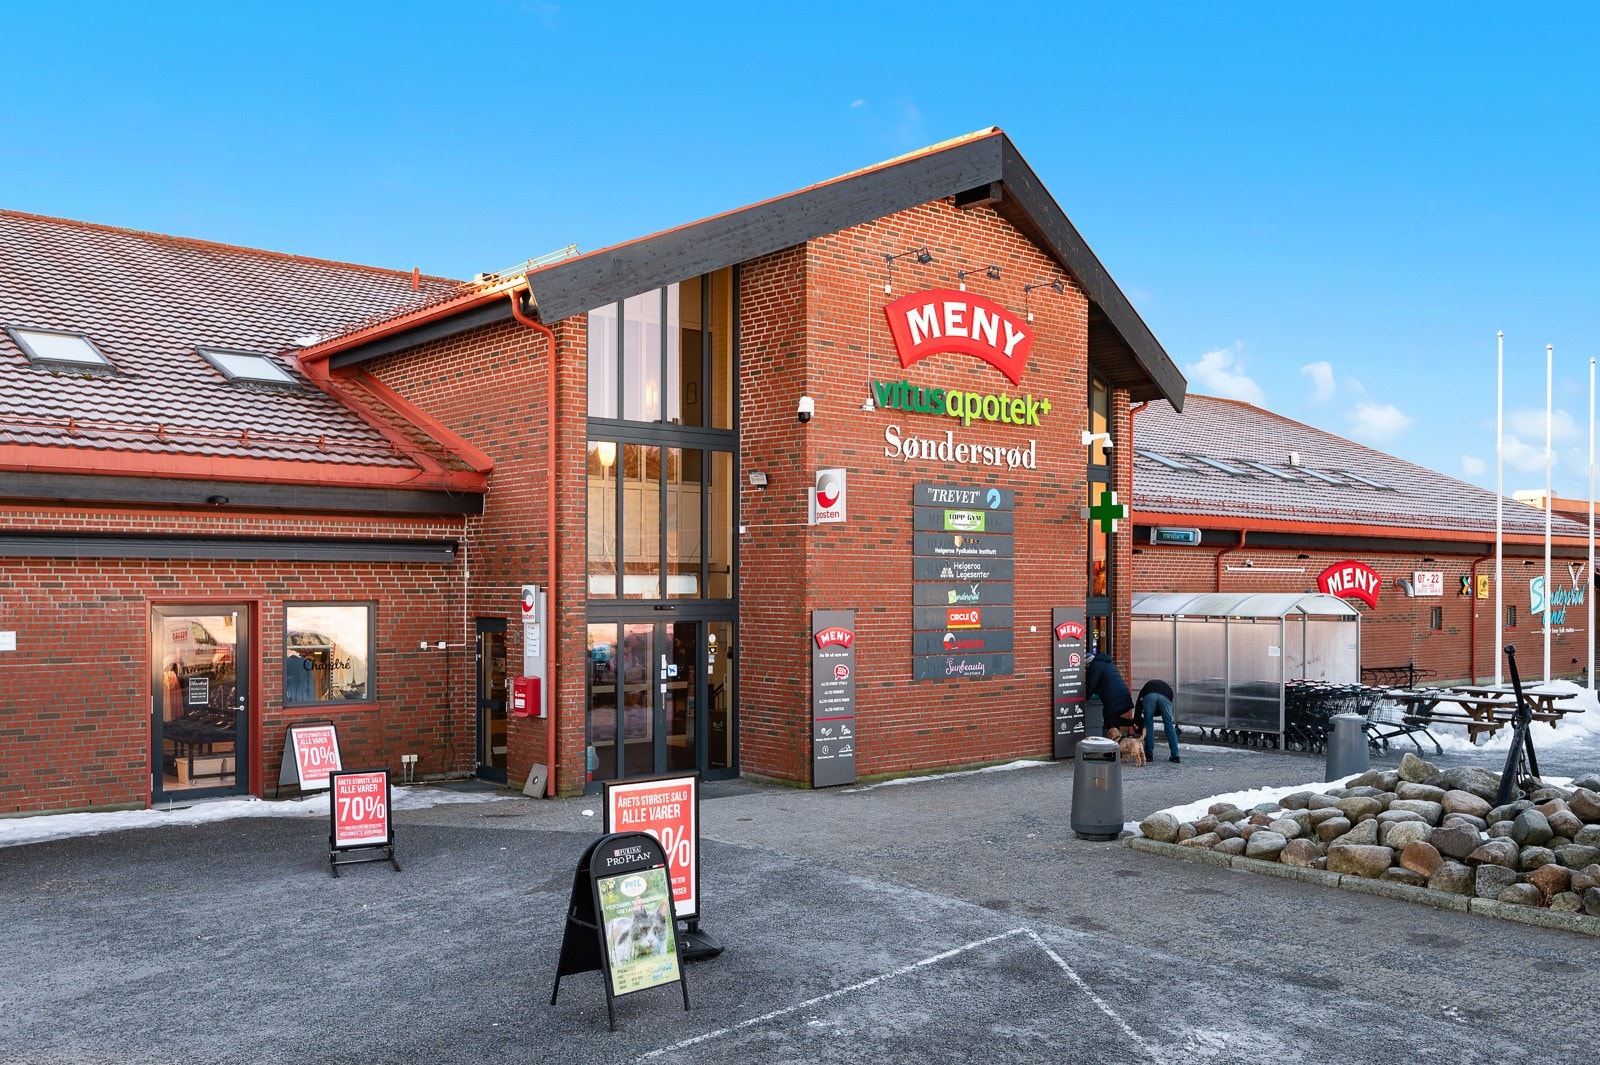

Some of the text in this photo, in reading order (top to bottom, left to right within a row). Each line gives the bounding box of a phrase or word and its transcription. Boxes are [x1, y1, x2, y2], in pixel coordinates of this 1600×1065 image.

[905, 301, 1026, 358] MENY
[884, 424, 1037, 471] Søndersrød
[816, 510, 840, 519] posten
[953, 561, 981, 571] Helgeroa
[956, 570, 990, 580] Legesenter
[1326, 567, 1379, 597] MENY
[1417, 574, 1426, 583] 07
[1431, 574, 1439, 583] 22
[949, 613, 970, 621] CIRCLE
[820, 630, 851, 644] MENY
[1059, 624, 1082, 636] MENY
[303, 657, 351, 671] Chandré
[945, 657, 985, 676] Sunbeauty
[299, 746, 336, 767] 70%
[340, 783, 378, 794] ALLE VARER
[617, 791, 688, 808] ÅRETS STØRSTE SALG
[338, 795, 385, 822] 70%
[622, 804, 681, 824] ALLE VARER
[606, 851, 651, 867] PRO PLAN
